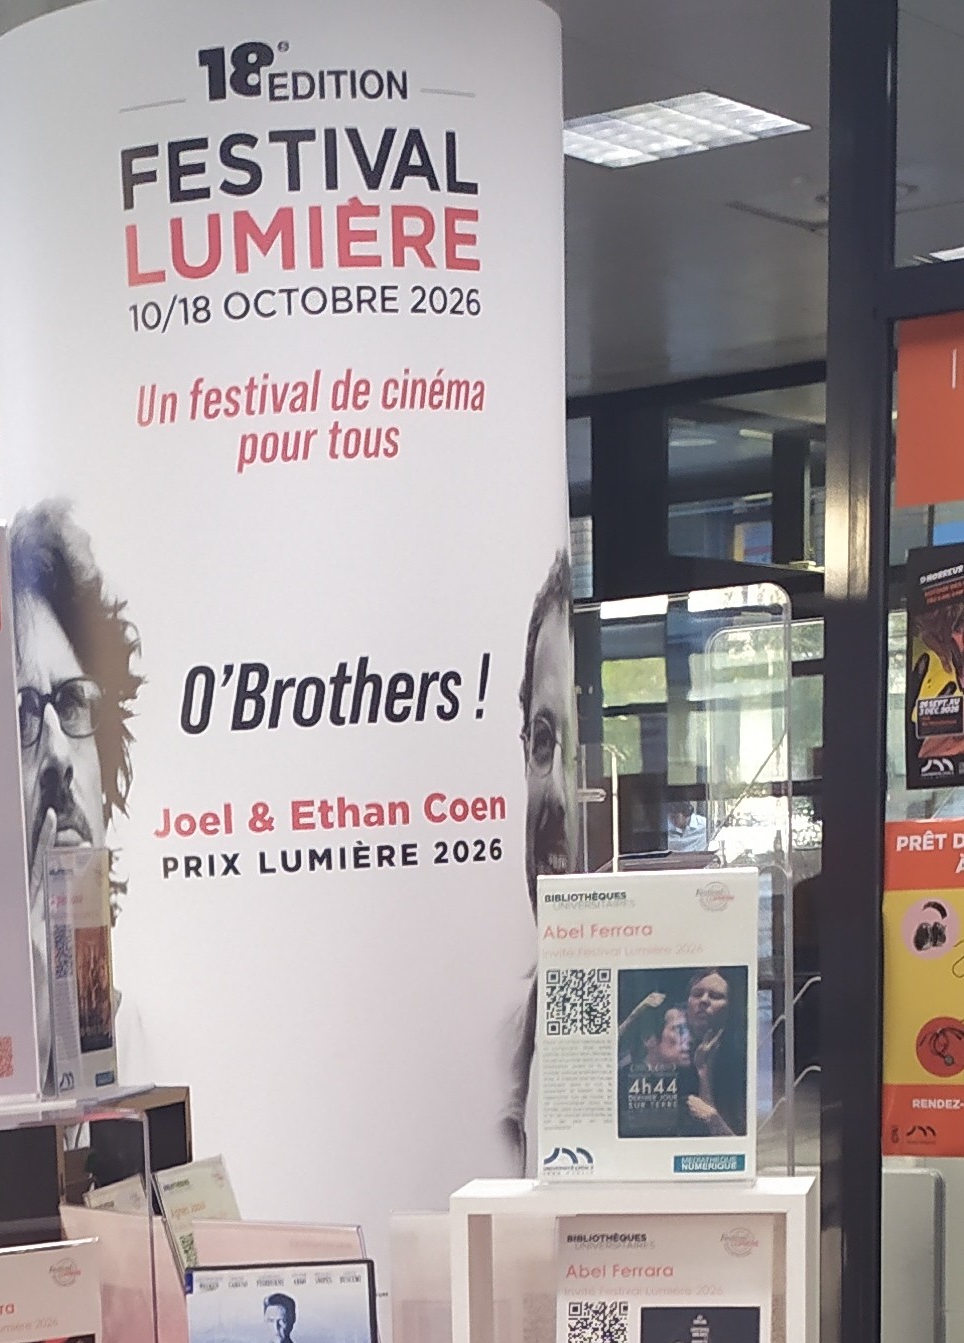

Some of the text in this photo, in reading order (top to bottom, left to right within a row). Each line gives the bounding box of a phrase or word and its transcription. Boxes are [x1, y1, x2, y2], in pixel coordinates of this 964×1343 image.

[268, 70, 409, 101] EDITION
[120, 127, 479, 211] FESTIVAL
[125, 196, 481, 287] LUMIÈRE
[128, 285, 481, 334] 10/18 OCTOBRE 2026
[135, 367, 486, 428] Un festival de cinéma
[237, 422, 400, 474] pour tous
[475, 653, 491, 720] !
[153, 792, 507, 839] Joel & Ethan Coen
[162, 838, 503, 880] PRIX LUMIÈRE 2026
[897, 830, 947, 851] PRÊT
[543, 924, 654, 940] Abel Ferrara
[628, 1078, 678, 1094] 4h44
[565, 1264, 674, 1279] Abel Ferrara
